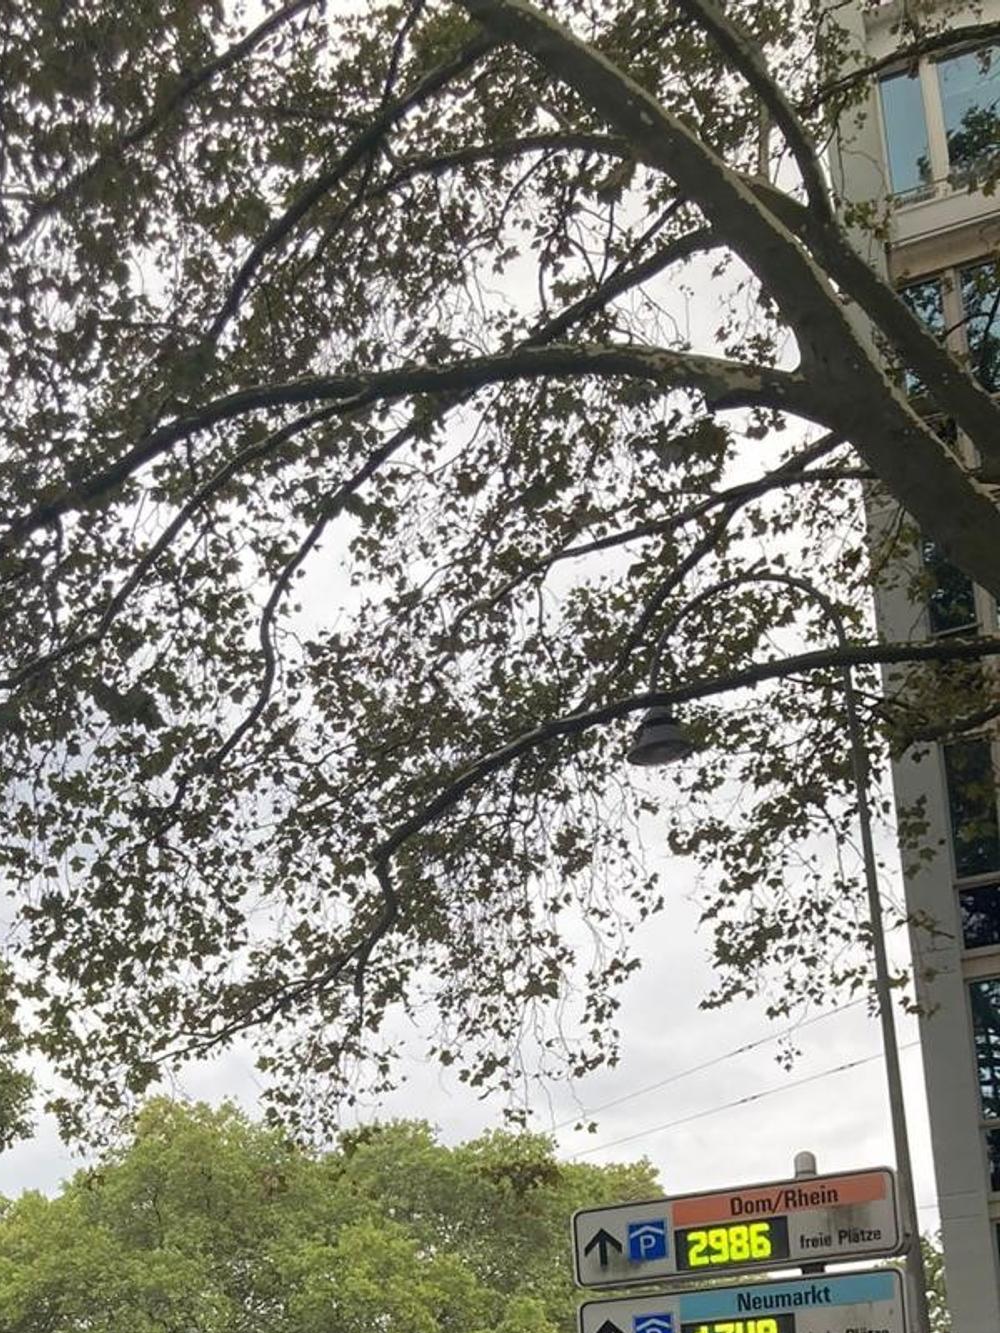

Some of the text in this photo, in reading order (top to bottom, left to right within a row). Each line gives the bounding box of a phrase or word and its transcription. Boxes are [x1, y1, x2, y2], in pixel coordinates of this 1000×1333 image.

[729, 1186, 840, 1217] Dom/Rhein
[687, 1221, 772, 1267] 2986
[799, 1226, 883, 1250] freie Plätze
[736, 1285, 832, 1313] Neumarkt
